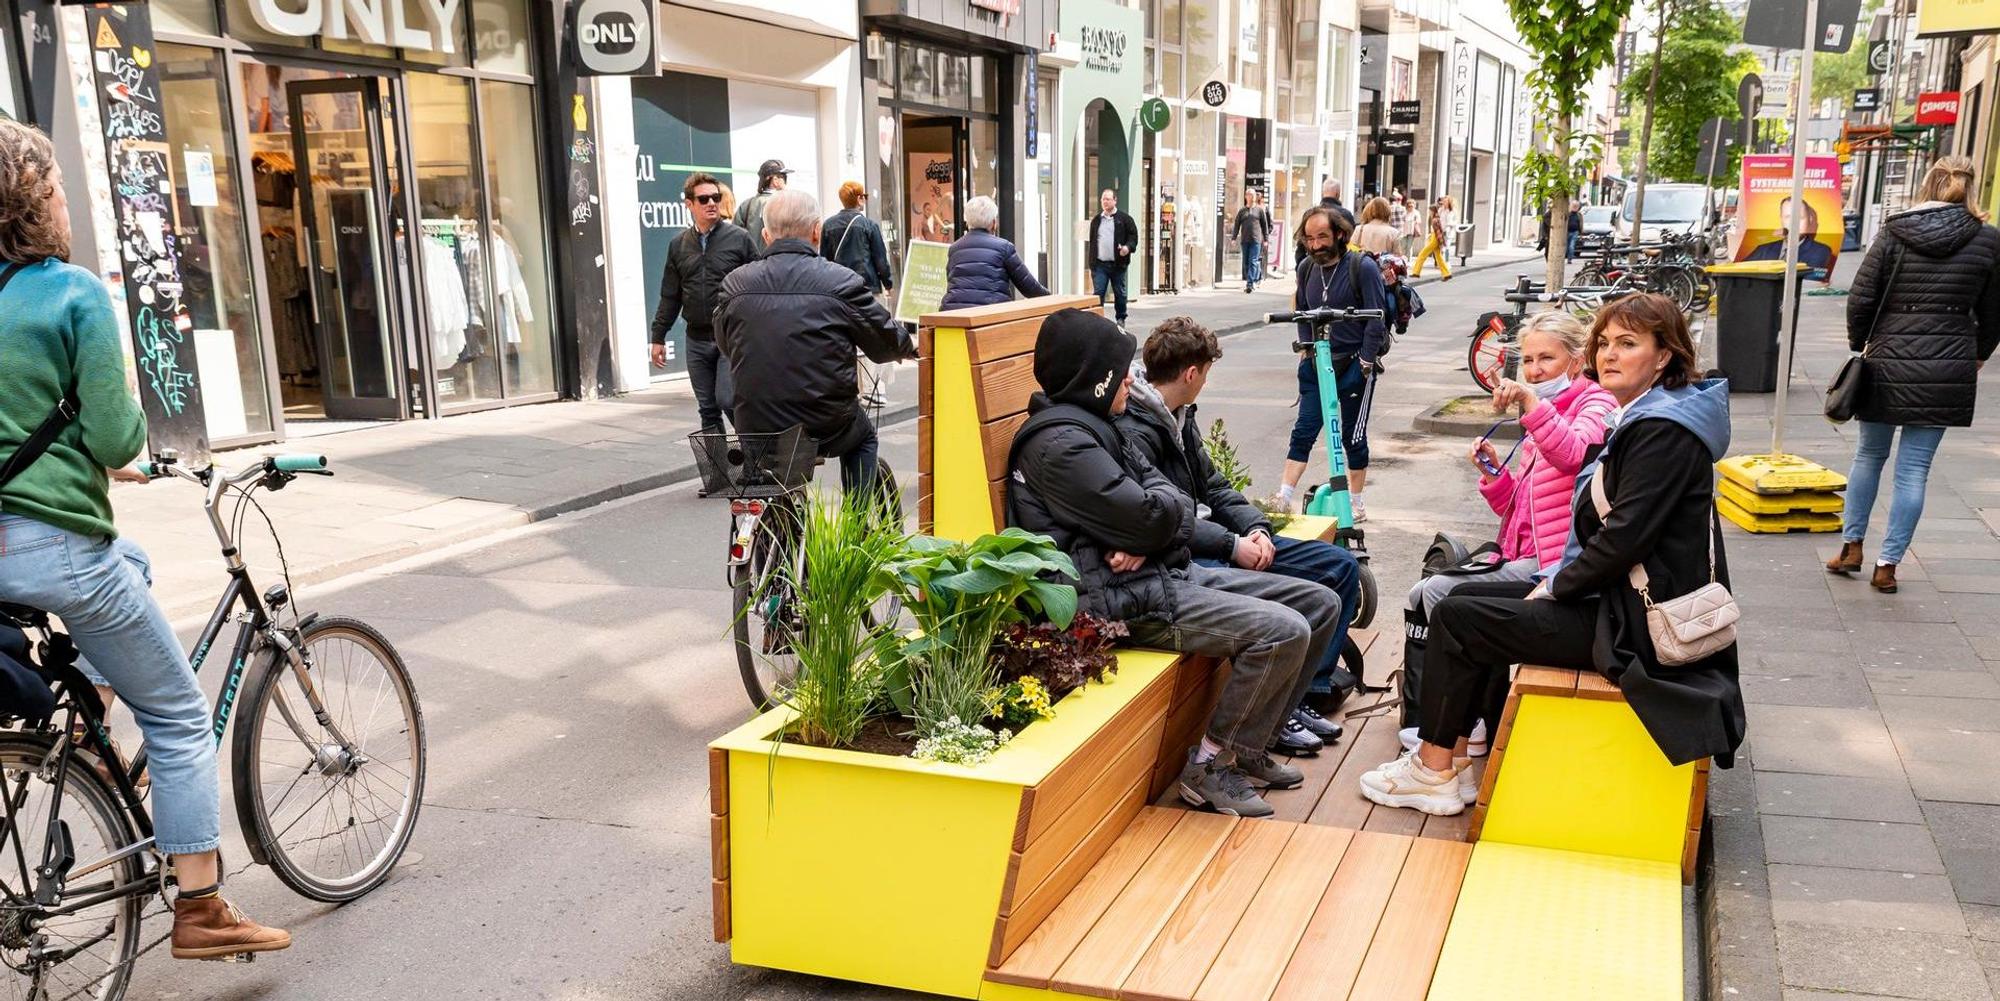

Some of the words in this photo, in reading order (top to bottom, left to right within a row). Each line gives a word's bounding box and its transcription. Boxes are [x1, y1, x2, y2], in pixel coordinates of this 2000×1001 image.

[33, 24, 51, 43] 34
[250, 0, 459, 54] ONLY
[581, 22, 645, 44] ONLY
[1453, 46, 1469, 135] ARKET
[1920, 101, 1958, 115] CAMPER
[1517, 91, 1530, 150] RKET
[1805, 169, 1827, 178] EIBT
[638, 191, 694, 229] ermi
[340, 226, 363, 235] ONLY
[1330, 417, 1345, 472] TIER
[214, 657, 245, 744] UGEOT
